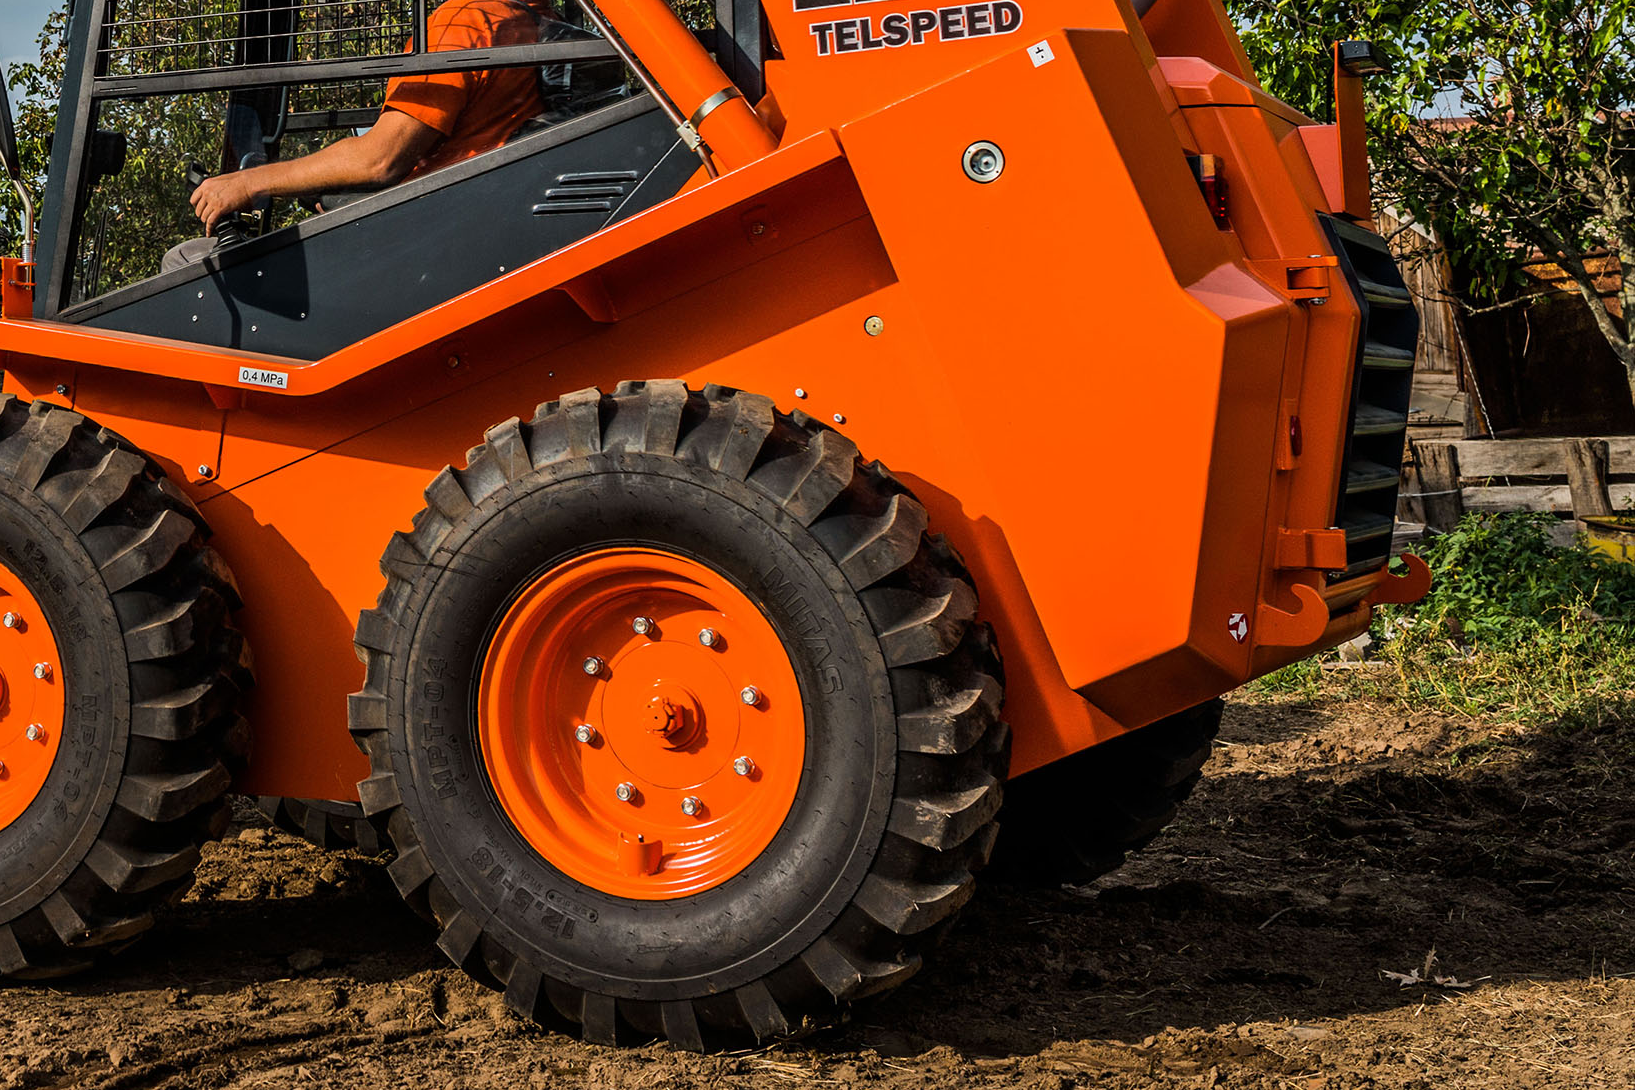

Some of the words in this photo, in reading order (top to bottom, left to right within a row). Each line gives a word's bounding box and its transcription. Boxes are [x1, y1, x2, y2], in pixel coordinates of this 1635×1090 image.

[809, 0, 1023, 56] TELSPEED
[242, 369, 258, 382] 0,4
[260, 371, 284, 386] MPa
[762, 564, 844, 695] MITAS
[423, 656, 458, 800] MPT-04
[470, 846, 577, 940] 12.5-18
